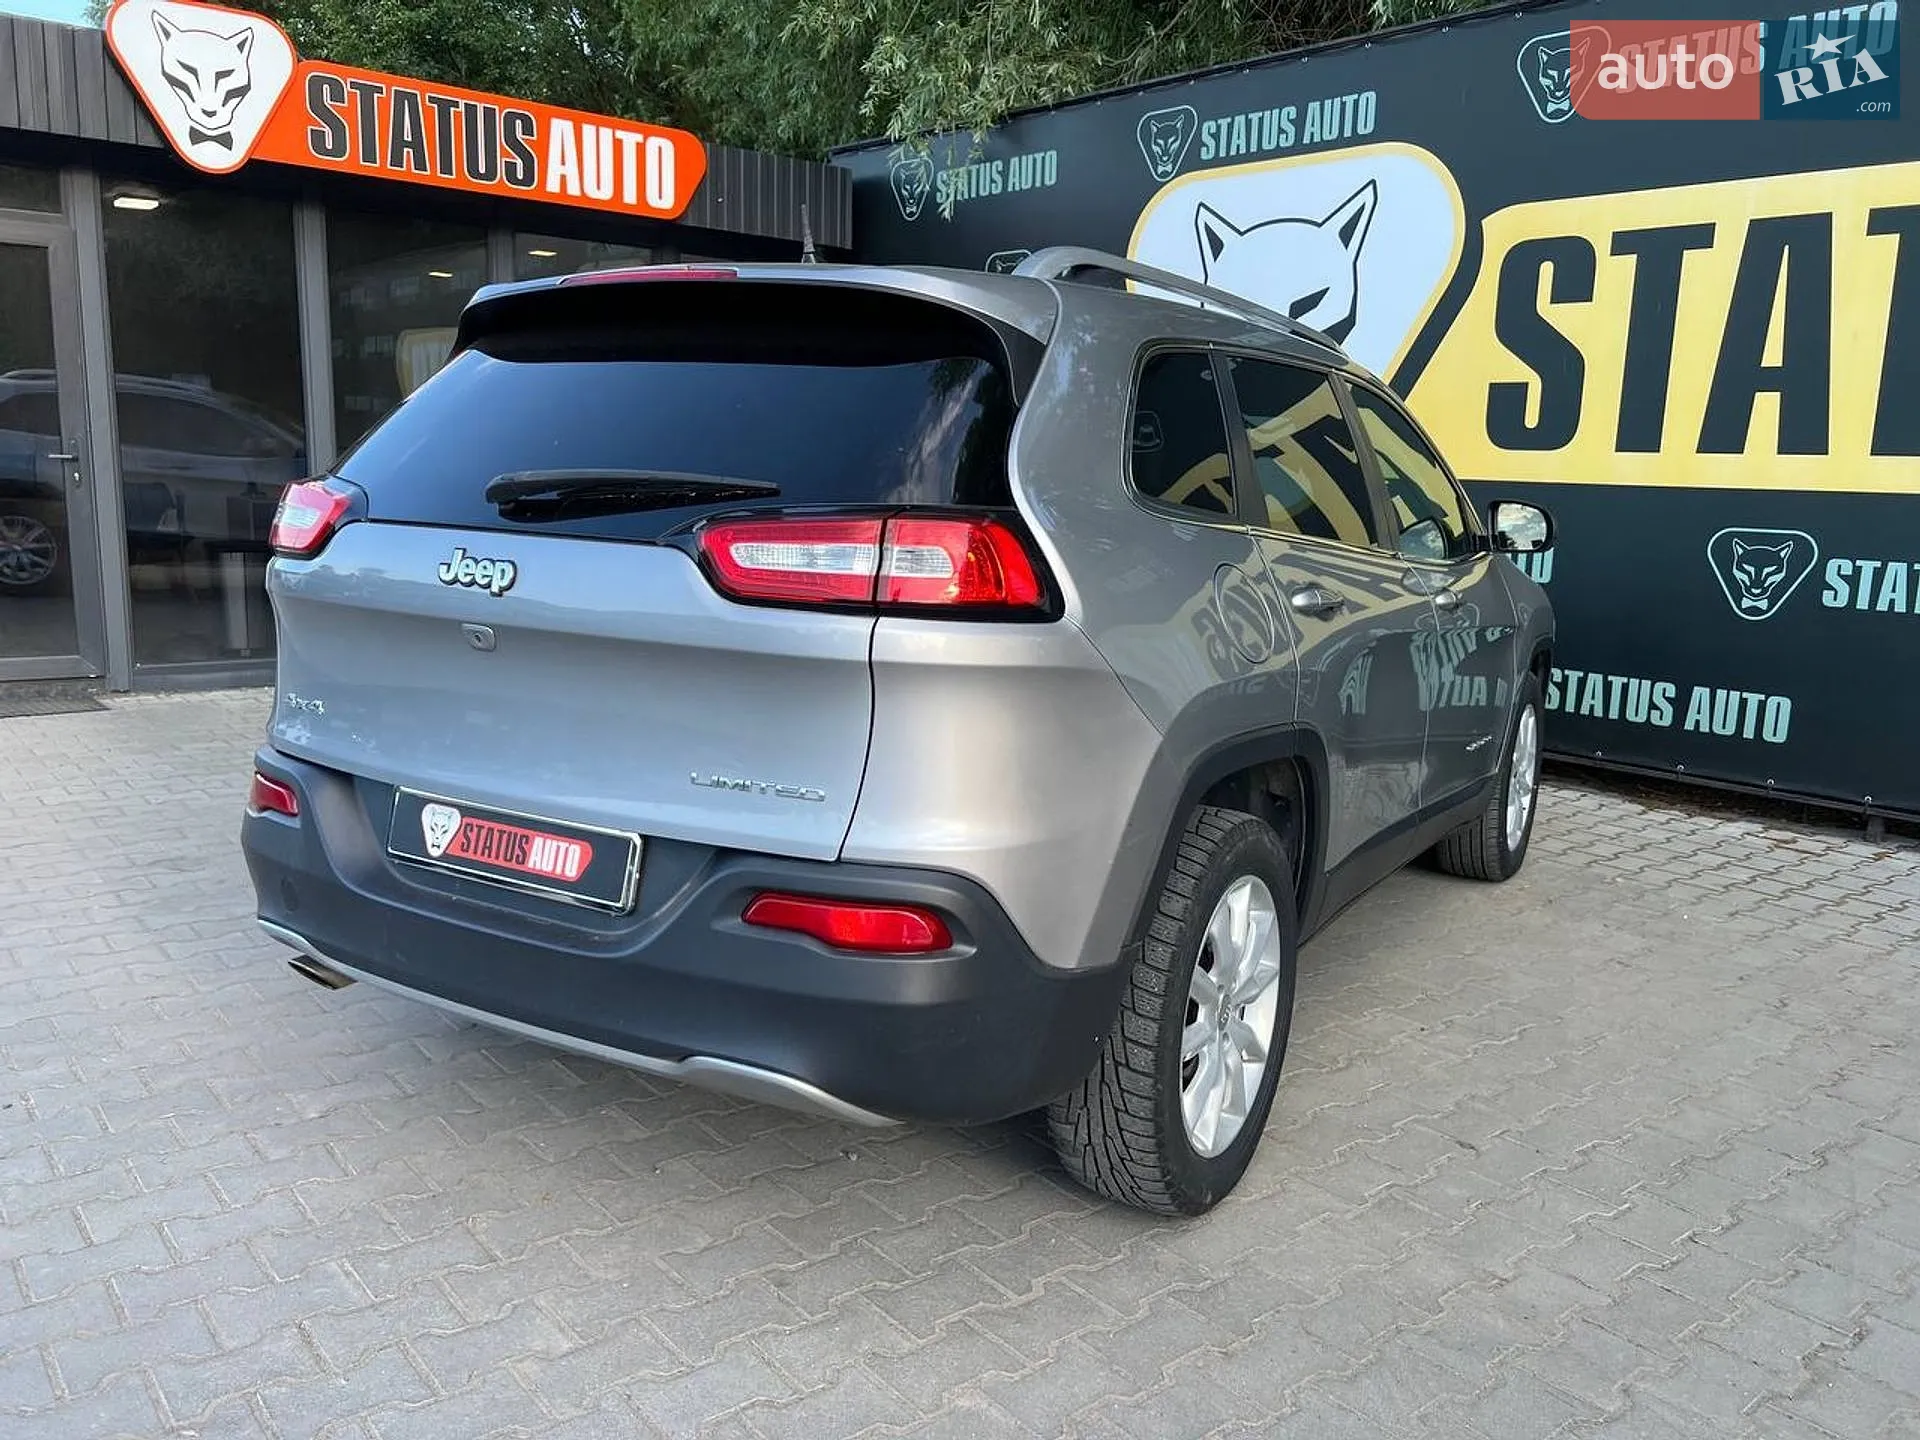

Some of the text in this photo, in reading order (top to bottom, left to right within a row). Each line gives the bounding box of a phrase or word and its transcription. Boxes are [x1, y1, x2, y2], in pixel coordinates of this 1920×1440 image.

[305, 72, 676, 210] STATUS AUTO
[1201, 91, 1377, 161] STATUS AUTO
[936, 150, 1058, 203] STATUS AUTO
[438, 547, 518, 597] Jeep
[1822, 558, 1920, 614] STA
[1545, 667, 1676, 728] STATUS
[1684, 686, 1793, 744] AUTO
[690, 771, 826, 801] LIMITED
[460, 822, 582, 877] STATUS AUTO
